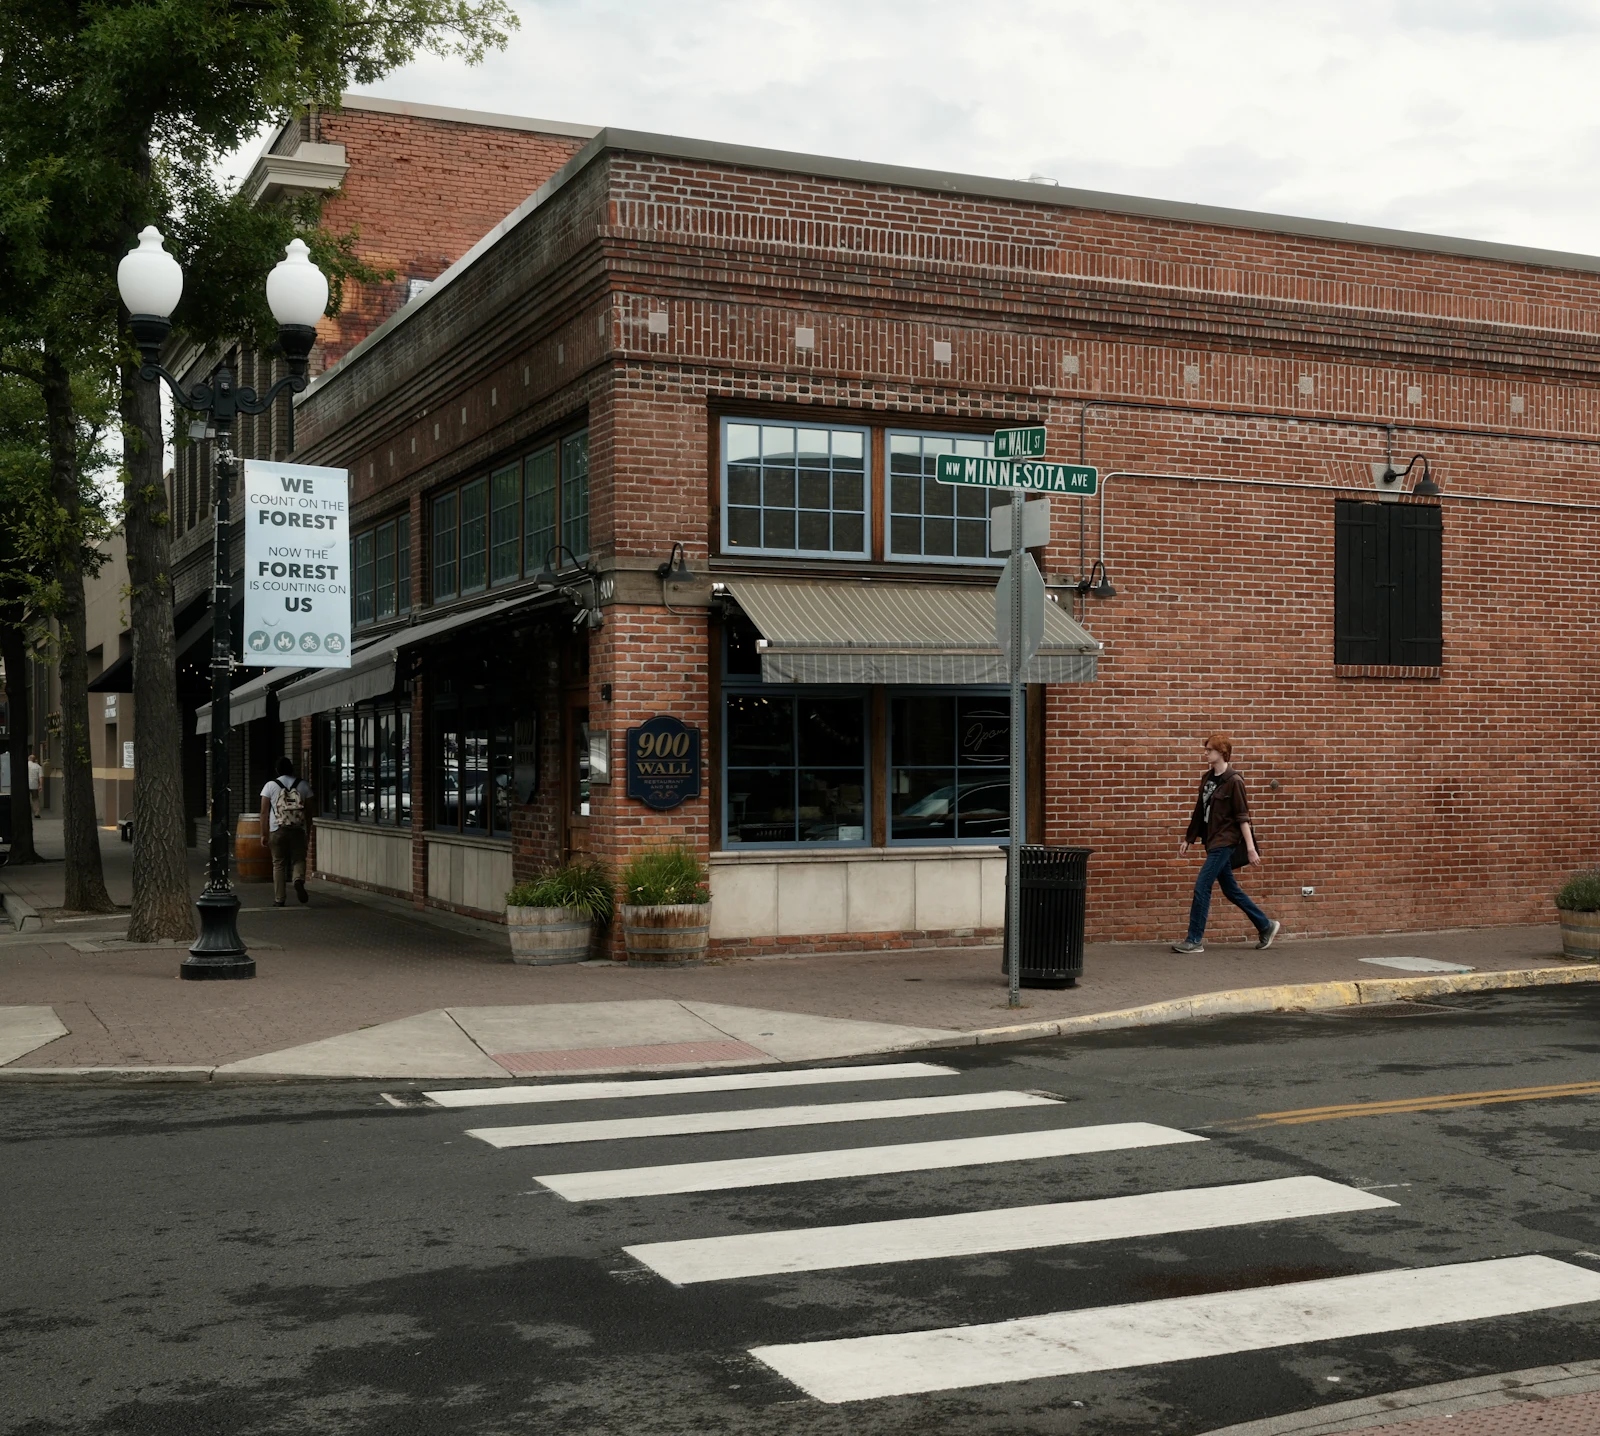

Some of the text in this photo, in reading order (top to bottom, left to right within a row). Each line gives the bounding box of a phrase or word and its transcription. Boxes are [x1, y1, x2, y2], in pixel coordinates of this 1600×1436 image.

[998, 430, 1041, 456] NW WALL ST
[945, 458, 1088, 491] NW MINNESOTA AVE
[280, 477, 314, 494] WE
[250, 493, 345, 511] COUNT ON THE
[259, 509, 338, 530] FOREST
[268, 546, 329, 560] NOW THE
[258, 561, 339, 580] FOREST
[249, 580, 346, 594] IS COUNTING ON
[284, 596, 313, 613] US
[636, 732, 690, 758] 900
[635, 762, 693, 775] WALL
